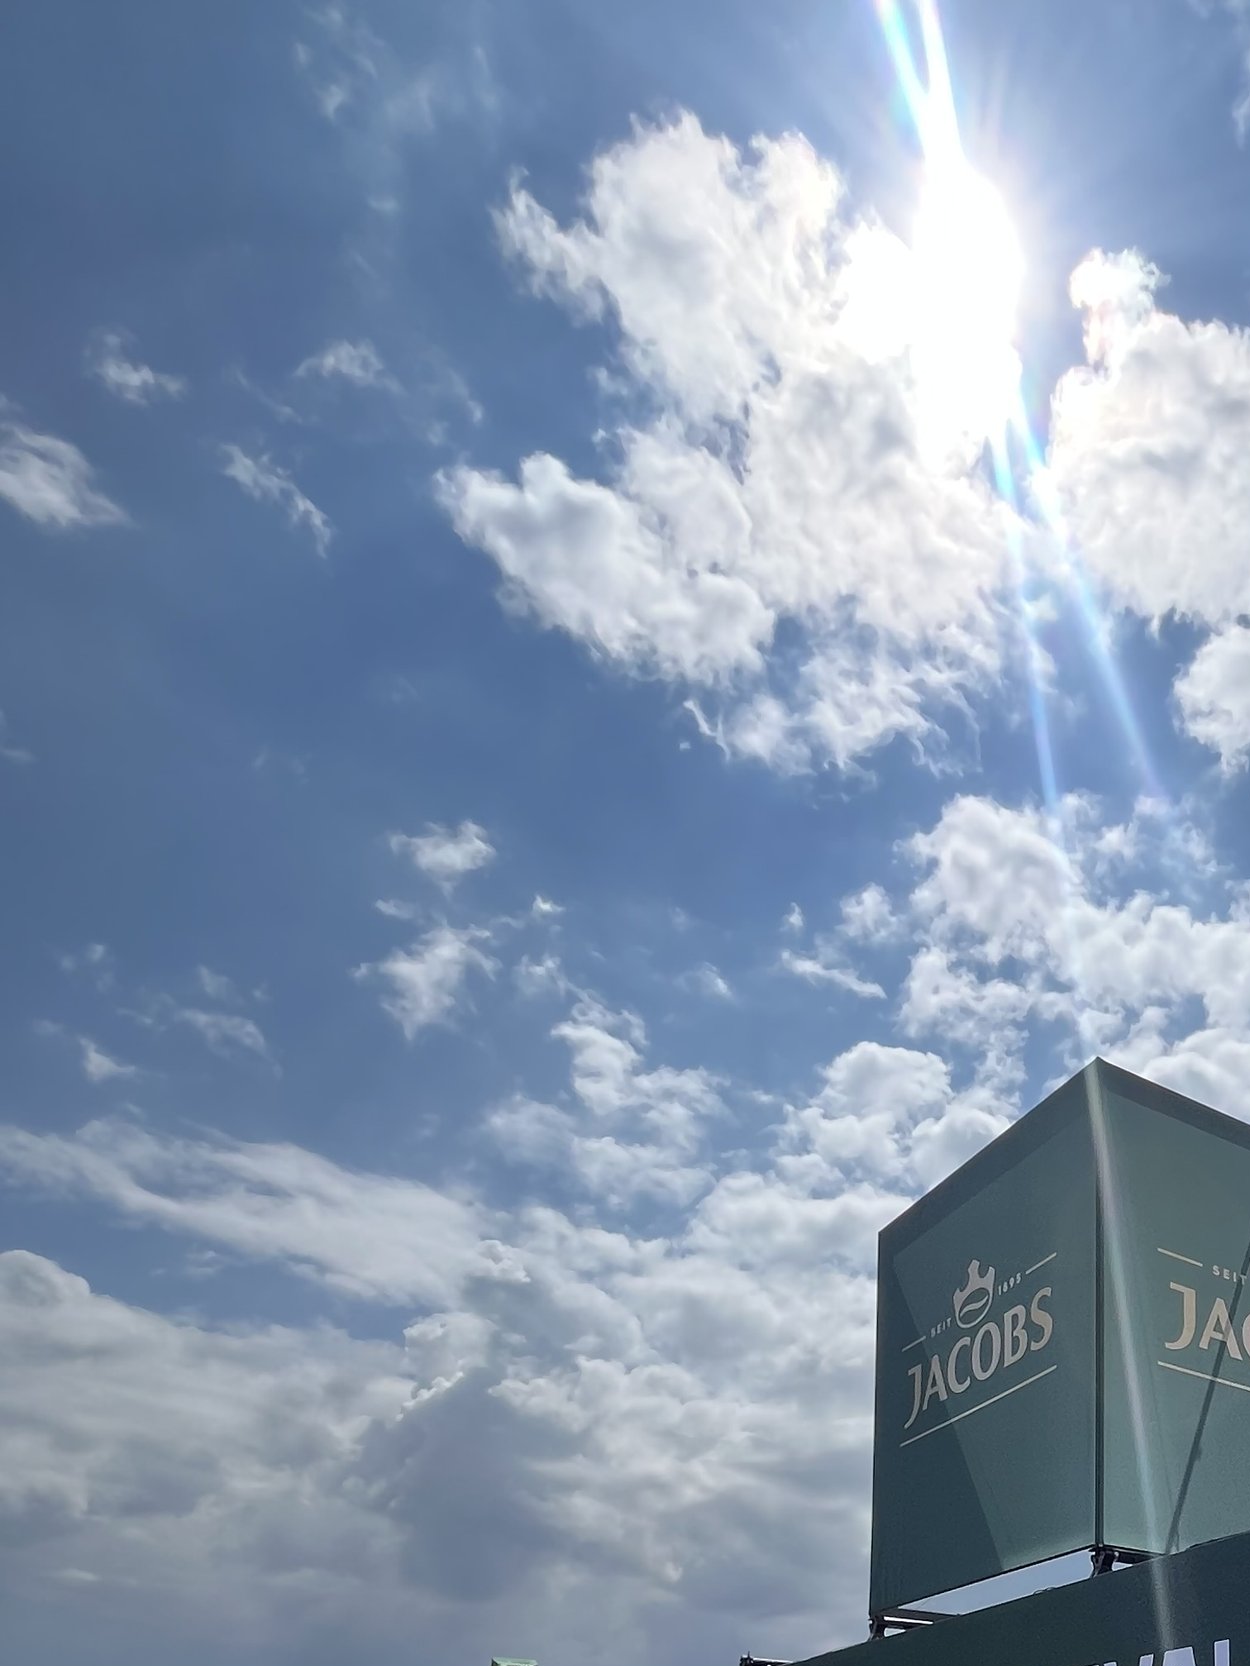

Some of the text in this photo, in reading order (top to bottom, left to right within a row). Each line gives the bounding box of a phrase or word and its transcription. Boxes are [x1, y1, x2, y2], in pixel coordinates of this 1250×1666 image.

[930, 1272, 1022, 1338] SEIT 1895
[1212, 1265, 1247, 1285] SEIT
[904, 1286, 1053, 1429] JACOBS
